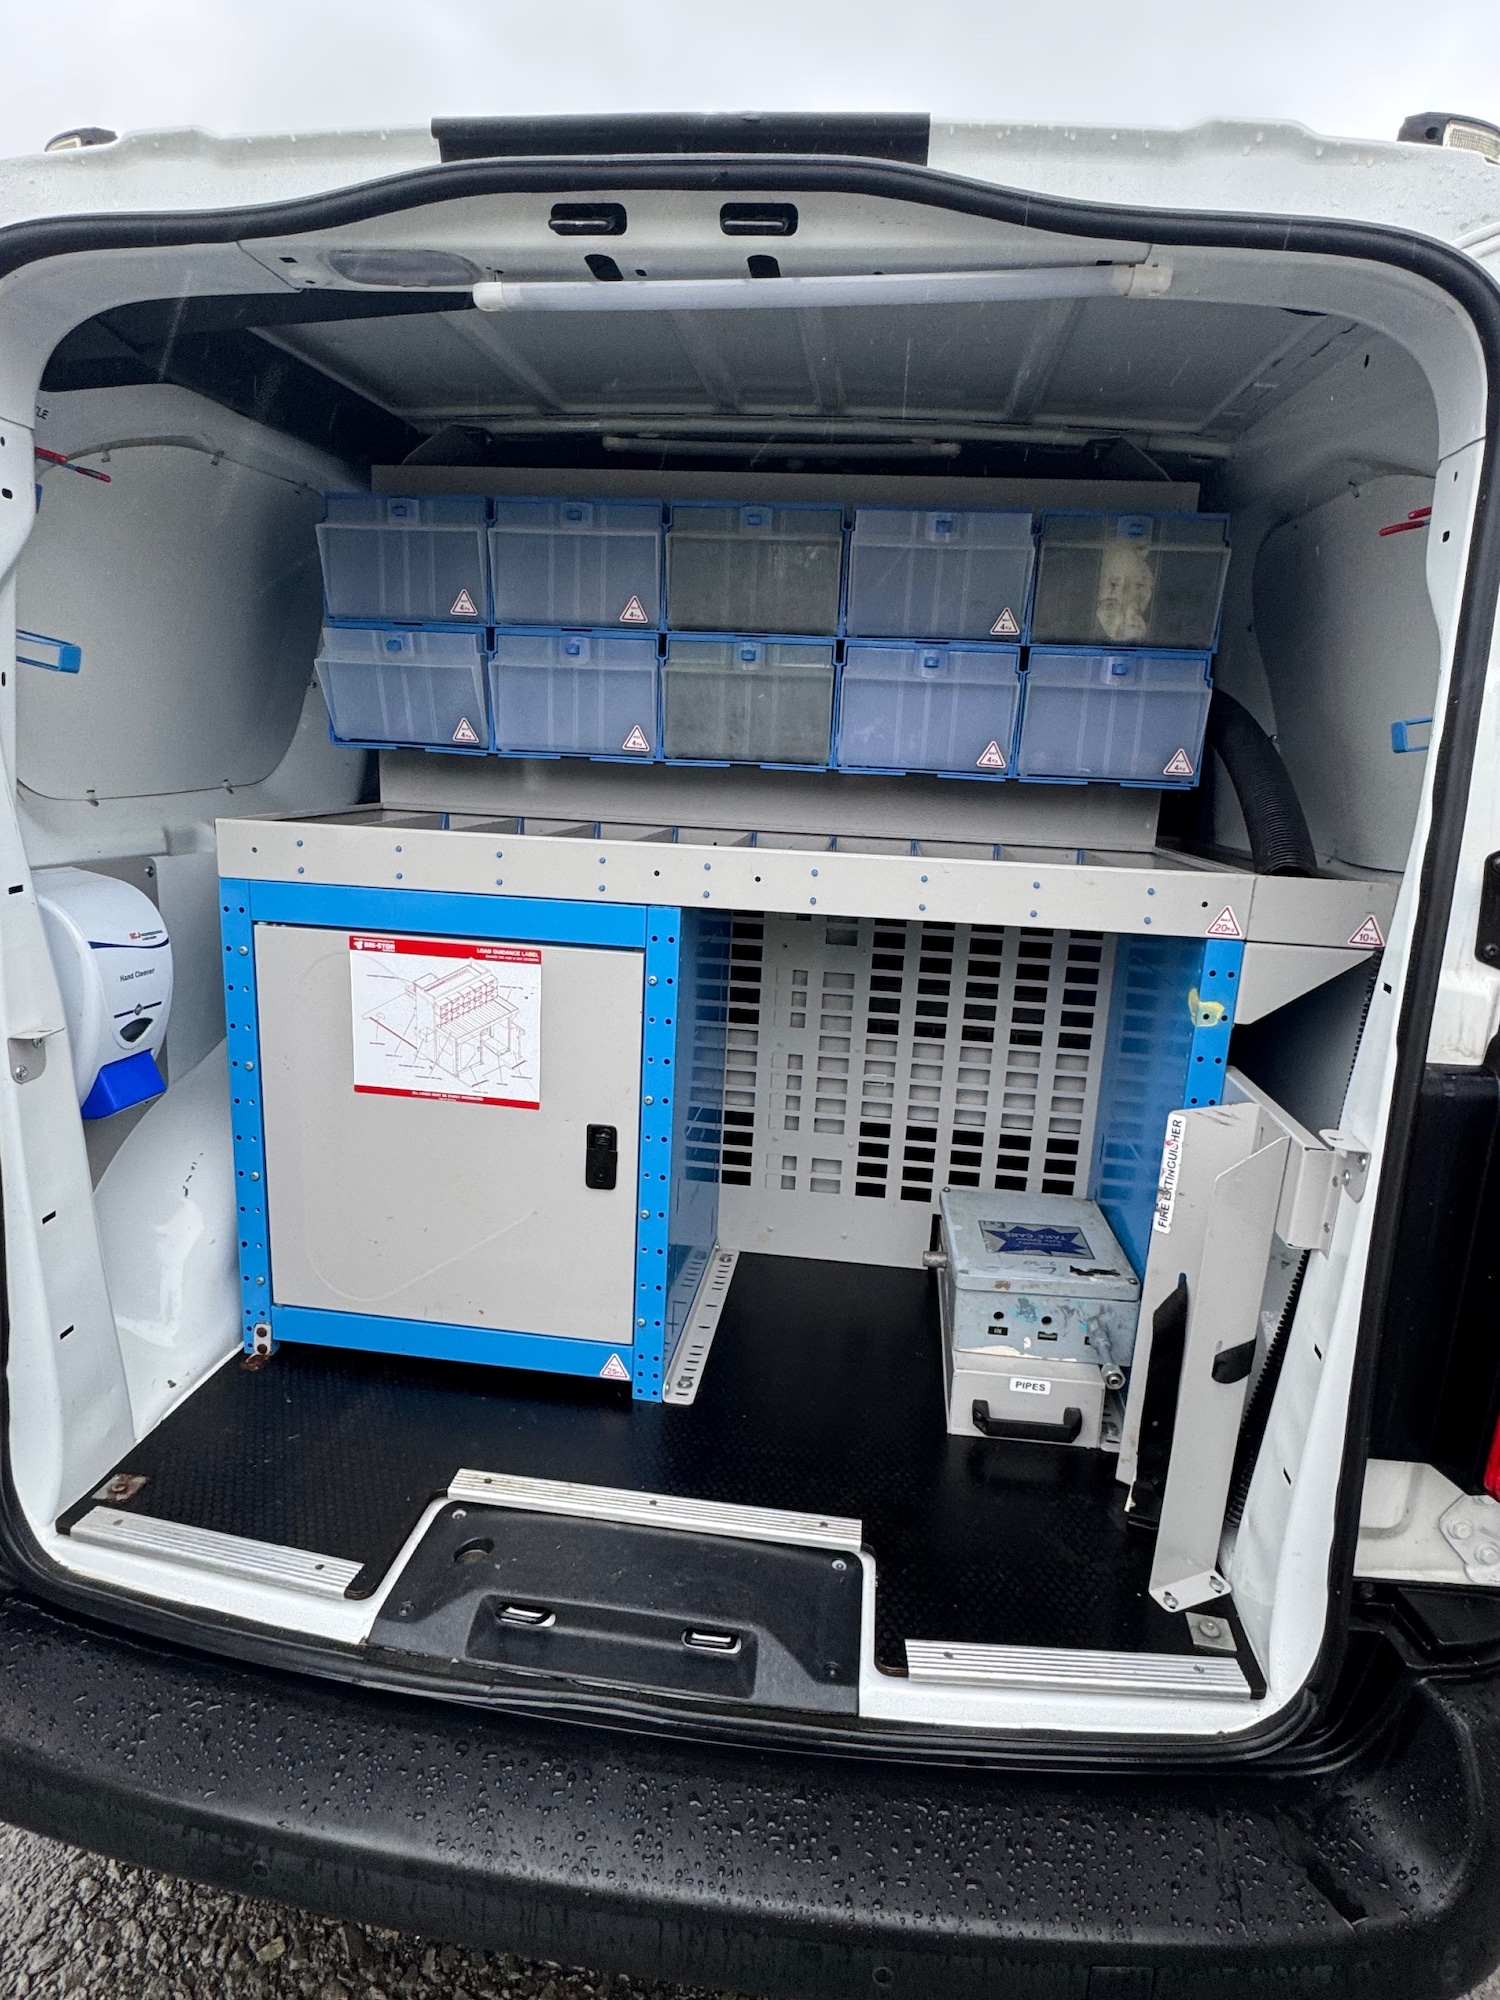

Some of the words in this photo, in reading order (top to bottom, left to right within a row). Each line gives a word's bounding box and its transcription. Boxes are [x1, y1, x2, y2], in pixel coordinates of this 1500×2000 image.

[119, 972, 134, 982] Hand
[134, 968, 156, 978] Cleaner
[1158, 1202, 1170, 1228] FIRE
[1015, 1381, 1046, 1391] PIPES
